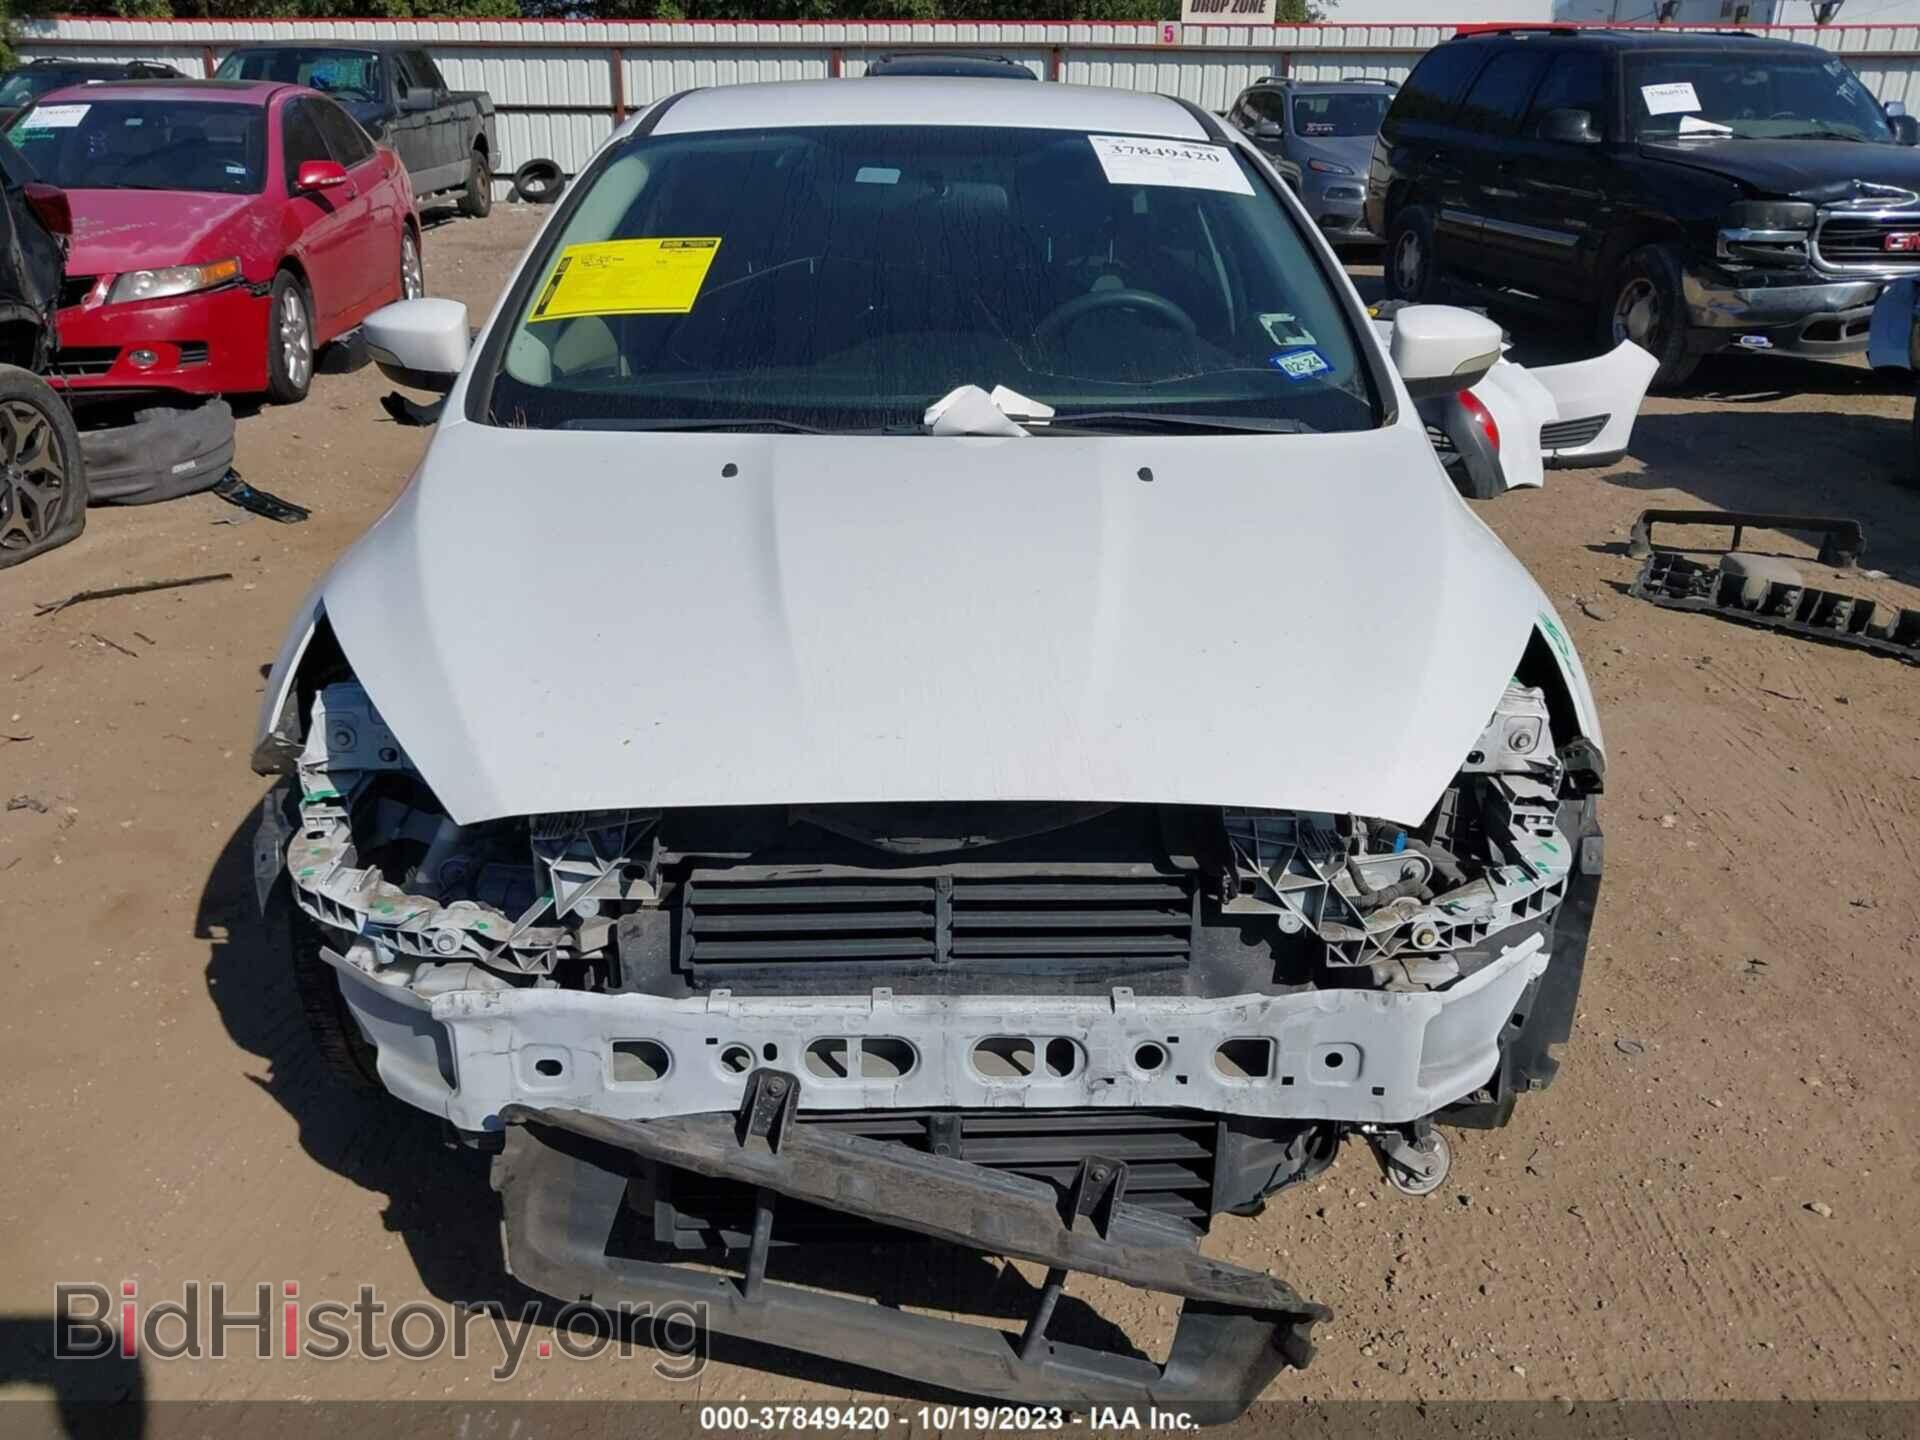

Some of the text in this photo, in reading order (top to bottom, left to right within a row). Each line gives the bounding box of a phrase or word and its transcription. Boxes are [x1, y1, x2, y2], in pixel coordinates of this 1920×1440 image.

[1190, 0, 1266, 13] DROP ZONE
[1163, 24, 1174, 43] 5
[1111, 144, 1221, 164] 37849420
